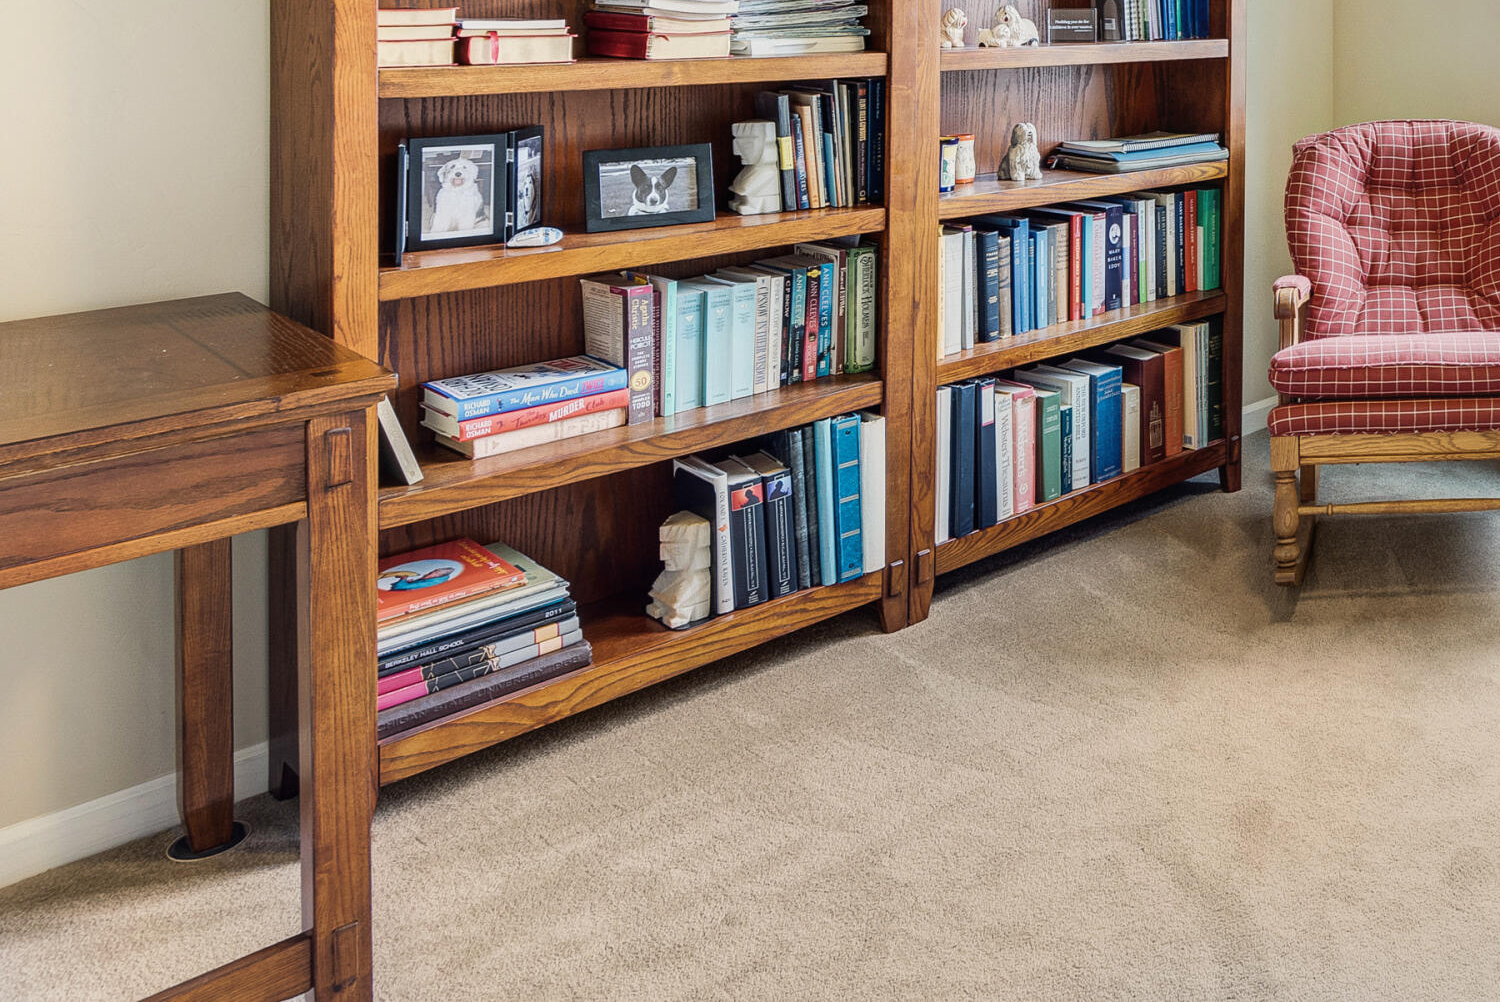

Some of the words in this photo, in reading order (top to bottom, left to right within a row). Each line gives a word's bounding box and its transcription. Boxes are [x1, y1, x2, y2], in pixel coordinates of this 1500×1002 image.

[810, 280, 818, 297] ANN
[631, 298, 640, 330] Christie
[640, 299, 649, 326] Agatha
[794, 295, 803, 329] CLEEVES
[809, 298, 817, 328] CLEEVES
[821, 290, 829, 327] CLEEVES
[861, 296, 872, 329] HOLMES
[635, 377, 647, 386] 50
[464, 400, 491, 410] RICHARD
[520, 392, 540, 406] Man
[541, 386, 558, 400] Who
[560, 382, 580, 398] Died
[586, 398, 605, 411] Club
[632, 400, 651, 410] TODD
[464, 407, 490, 417] OSMAN
[549, 399, 585, 422] MURDER
[465, 420, 492, 431] RICHARD
[466, 428, 492, 438] OSMAN
[1001, 459, 1011, 508] Thesaurus
[720, 535, 728, 566] CATHERINE
[721, 567, 729, 587] RAVEN
[385, 655, 418, 669] BERKELEY
[420, 649, 437, 659] HALL
[439, 640, 464, 653] SCHOOL
[545, 608, 563, 618] 2011
[378, 710, 427, 731] CHIGAN
[478, 668, 547, 698] UNIVERSITY
